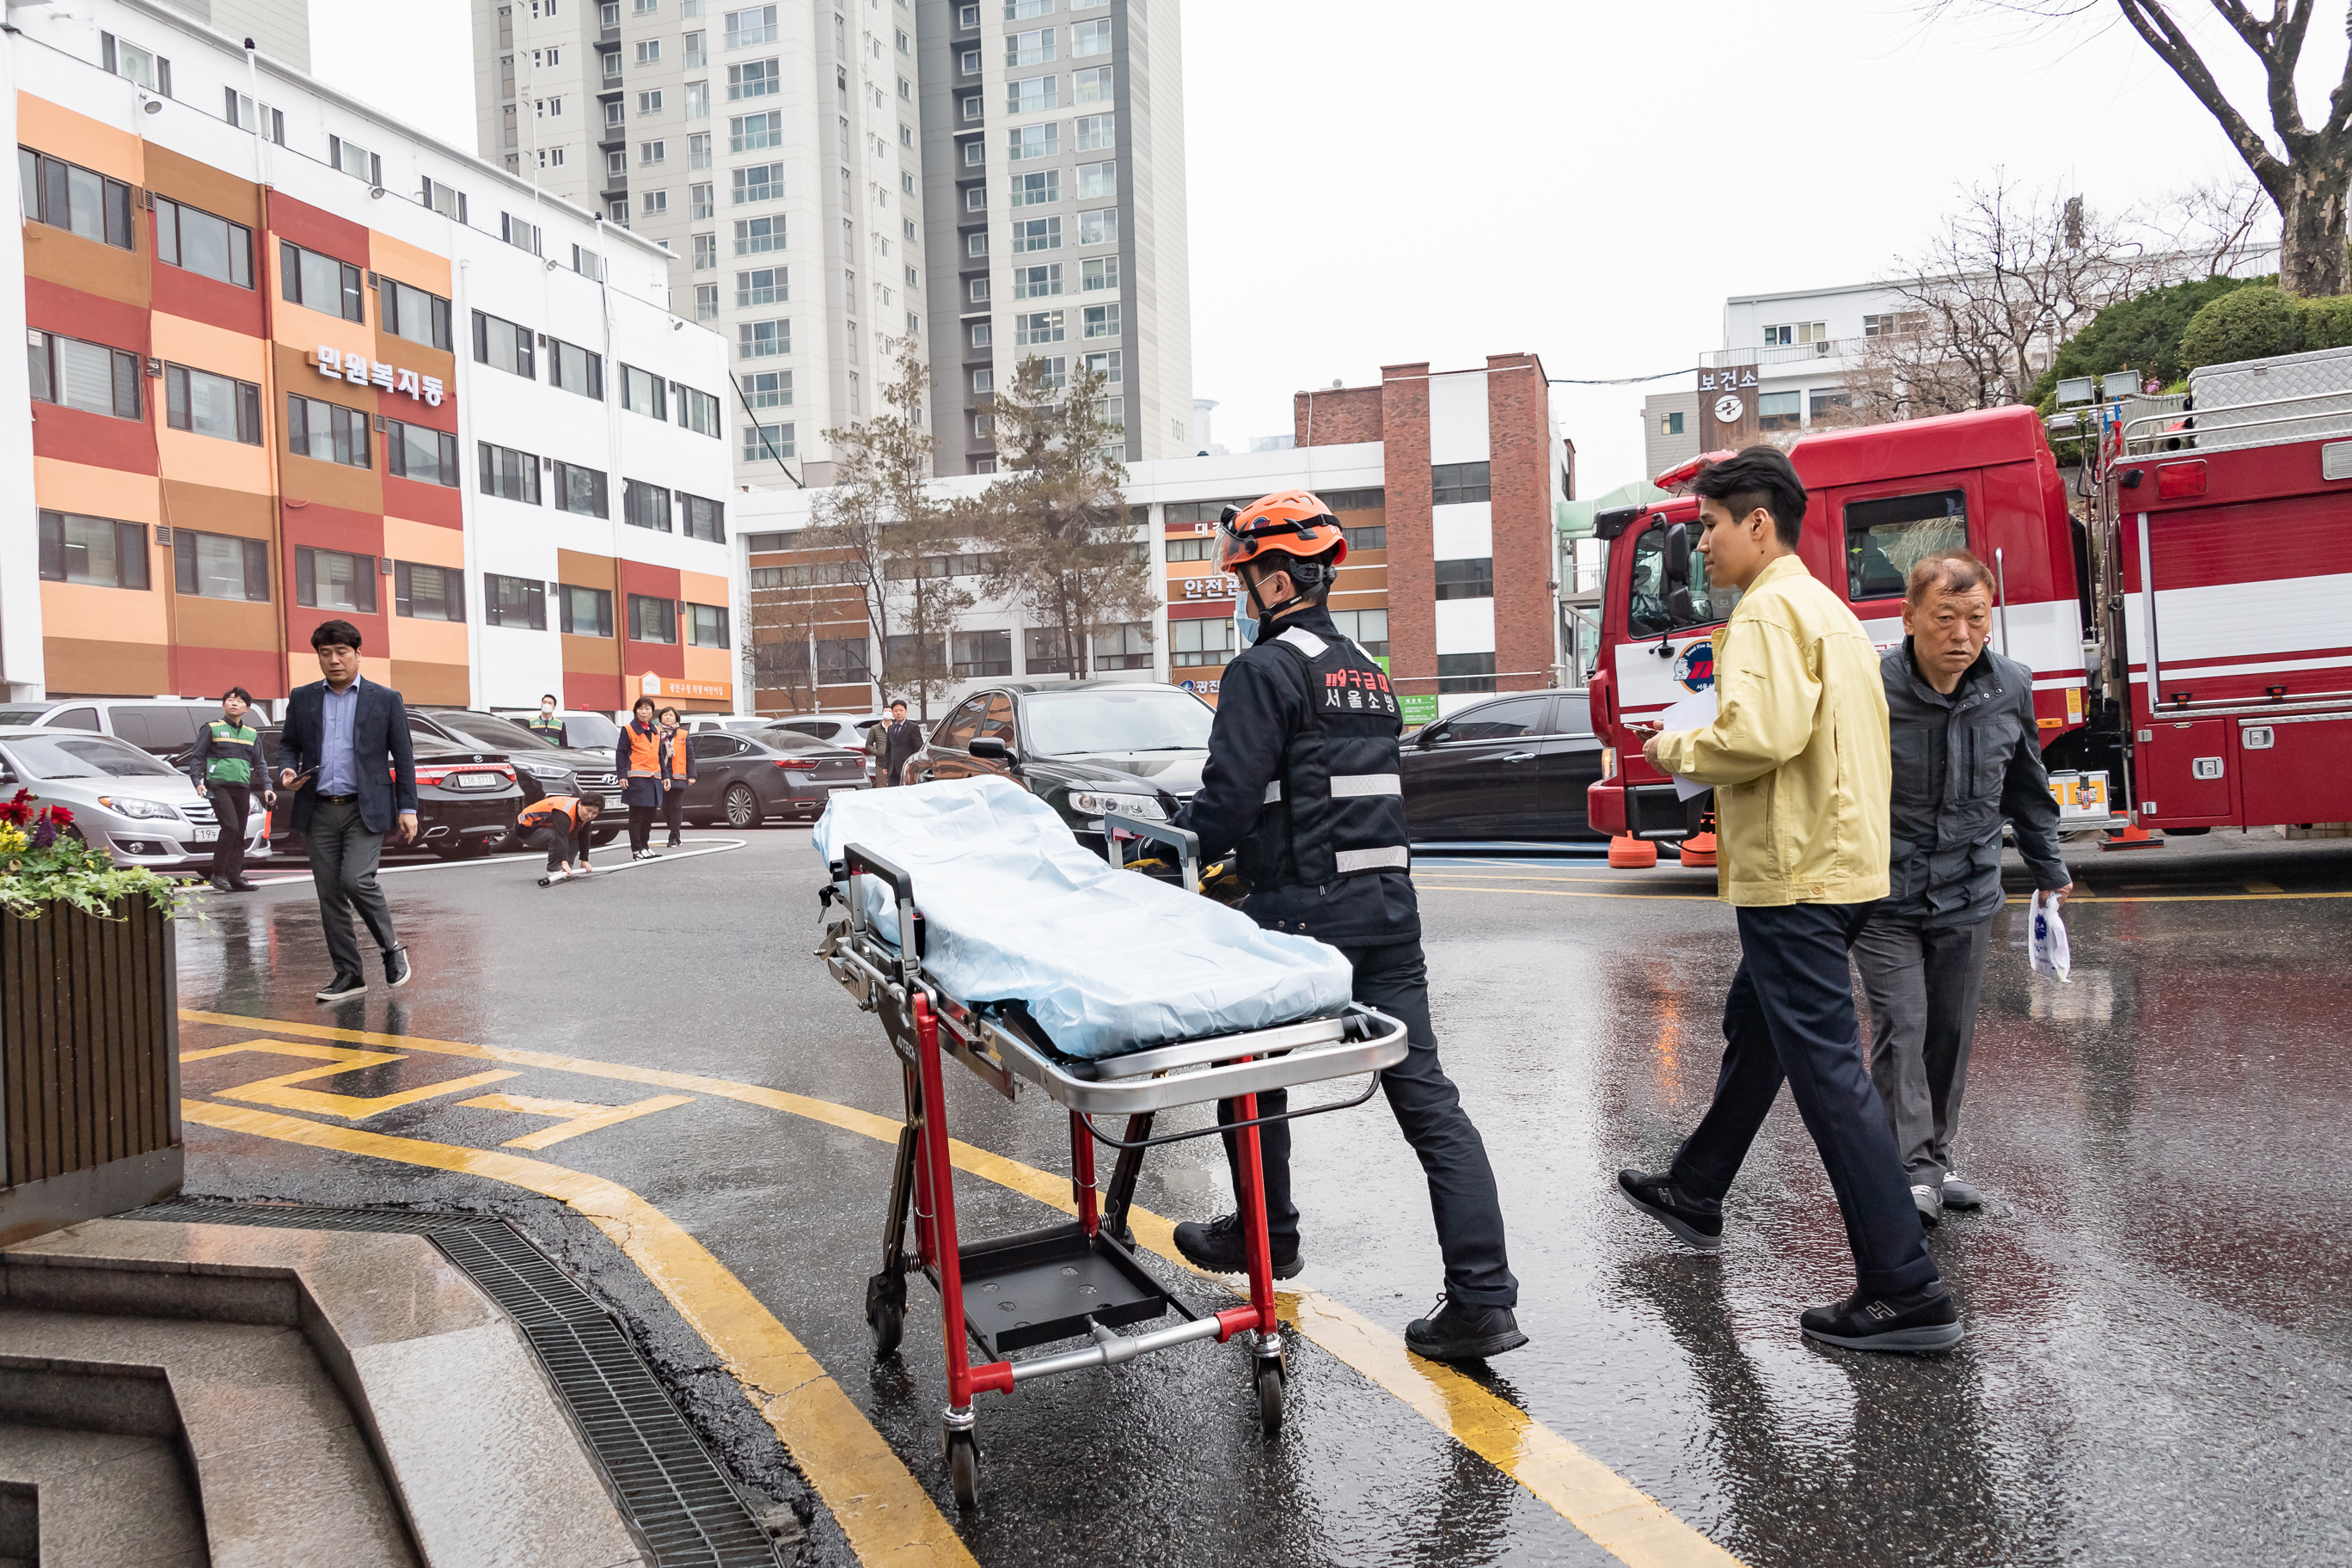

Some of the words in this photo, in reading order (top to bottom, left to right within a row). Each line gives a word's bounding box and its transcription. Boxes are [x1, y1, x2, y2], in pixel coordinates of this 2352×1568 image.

[318, 345, 444, 407] 민원복지동
[1700, 370, 1758, 392] 보건소
[1172, 418, 1184, 442] 101
[1326, 689, 1395, 713] 서울소방
